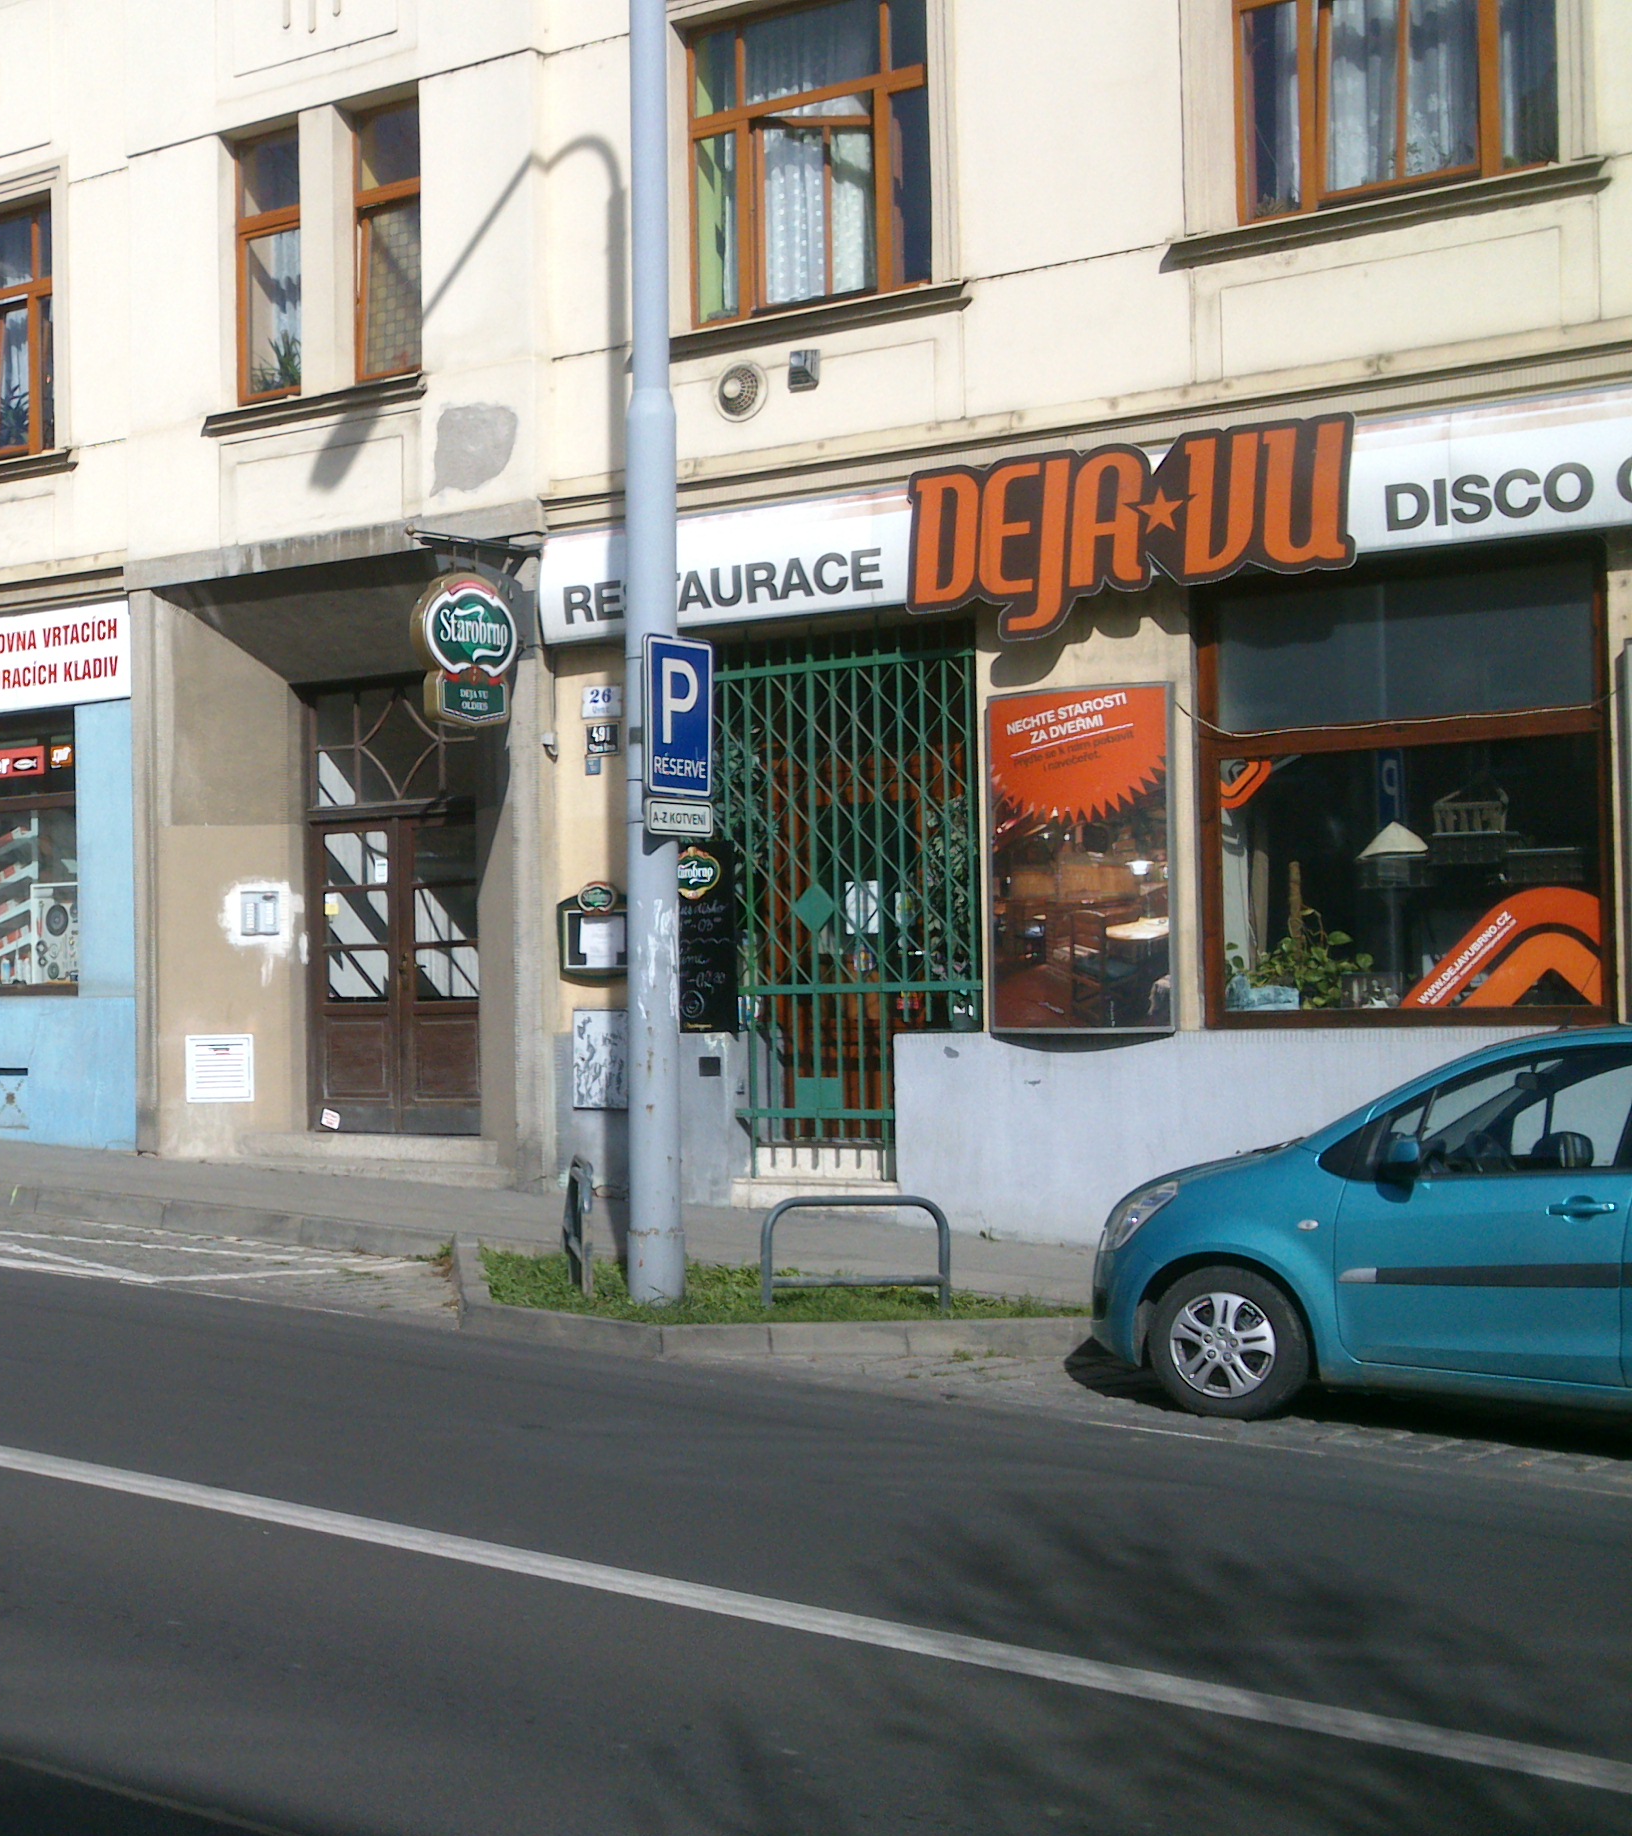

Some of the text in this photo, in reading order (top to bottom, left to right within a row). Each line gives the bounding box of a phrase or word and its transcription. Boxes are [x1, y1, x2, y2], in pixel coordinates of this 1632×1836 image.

[1385, 462, 1594, 532] DISCO
[915, 421, 1346, 632] DEJA VU
[563, 547, 883, 625] REAURACE
[43, 616, 118, 648] VRTACÍCH
[439, 604, 508, 654] Starobrno
[64, 655, 118, 682] KLADIV
[590, 688, 612, 703] 26
[662, 657, 699, 744] P
[1006, 692, 1128, 736] NECHTE STAROSTI
[591, 726, 610, 742] 491
[1030, 714, 1104, 744] ZA DVEŘMI
[653, 811, 706, 825] A-Z KOTVENÍ
[1417, 911, 1512, 1005] WWW.DEJAVUBRNO.CZ
